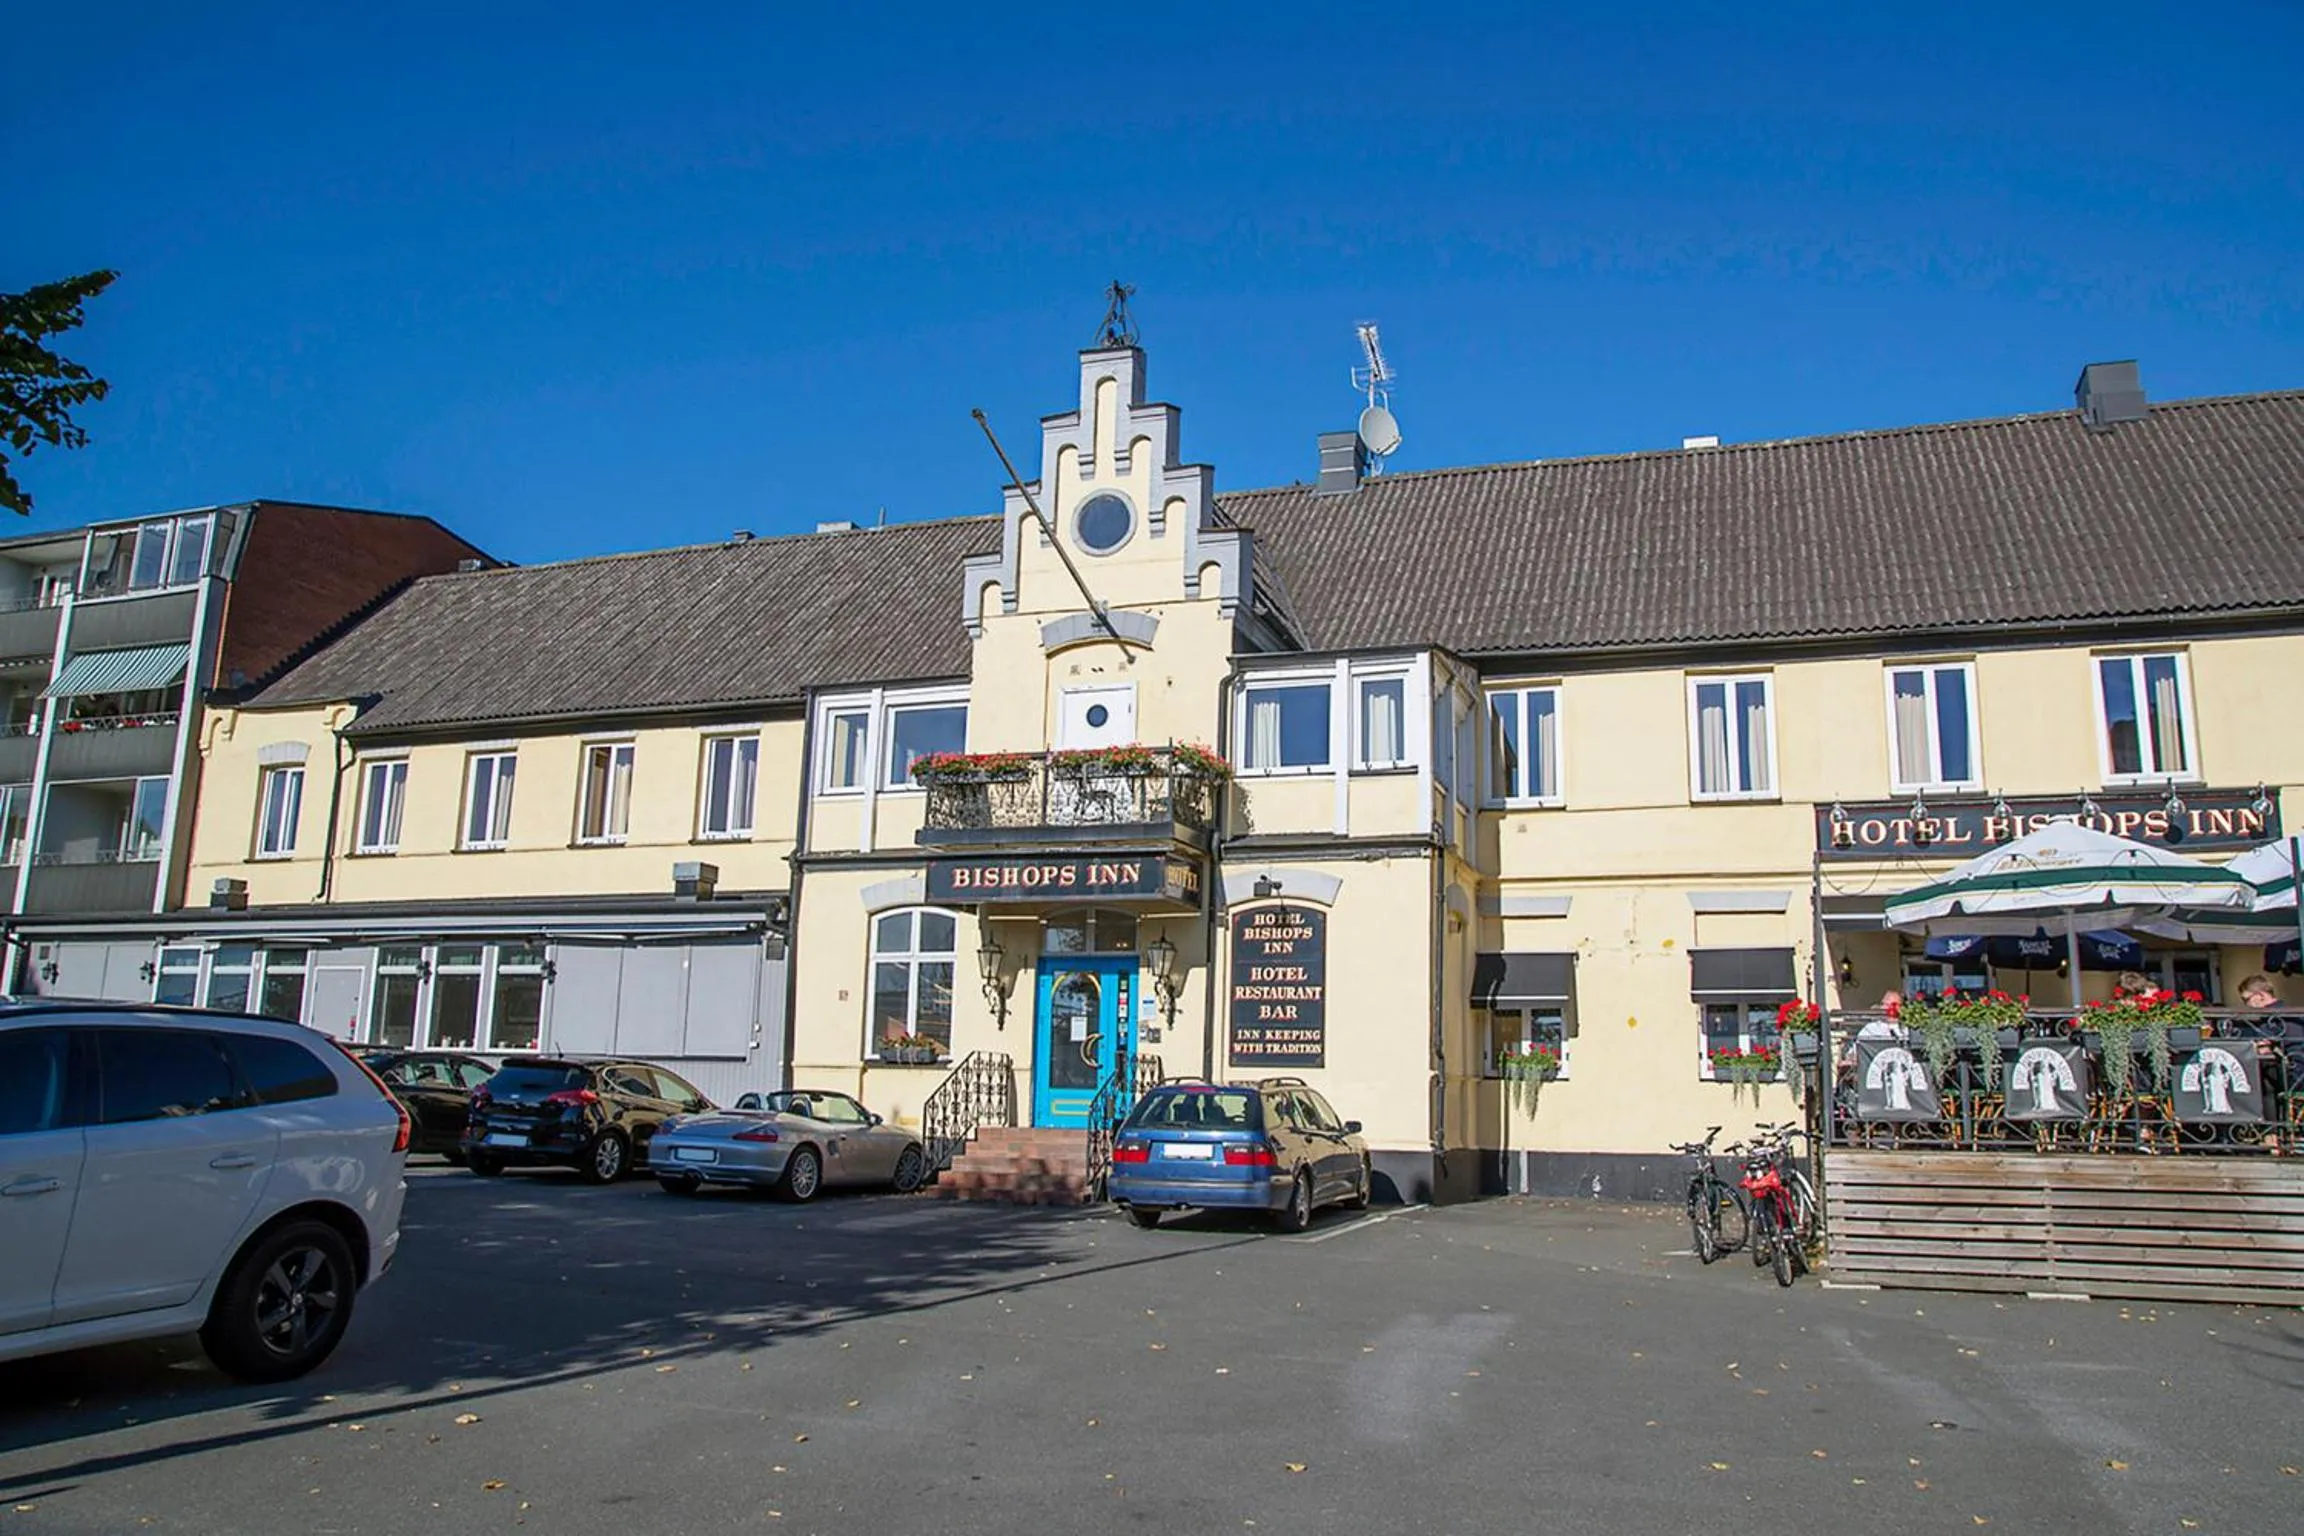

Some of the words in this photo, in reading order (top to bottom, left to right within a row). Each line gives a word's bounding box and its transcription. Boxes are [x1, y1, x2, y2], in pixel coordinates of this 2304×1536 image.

[1831, 816, 1972, 847] HOTEL
[2188, 808, 2264, 836] INN
[952, 865, 1077, 888] BISHOPS
[1085, 863, 1141, 886] INN
[1243, 927, 1313, 940] BISHOPS
[1263, 942, 1294, 953] INN
[1250, 967, 1308, 981] HOTEL
[1234, 986, 1322, 1000] RESTAURANT
[1258, 1005, 1298, 1019] BAR
[1237, 1029, 1261, 1040] INN
[1264, 1029, 1321, 1040] KEEPING
[1233, 1043, 1263, 1054] WITH
[1265, 1043, 1322, 1054] TRADITION
